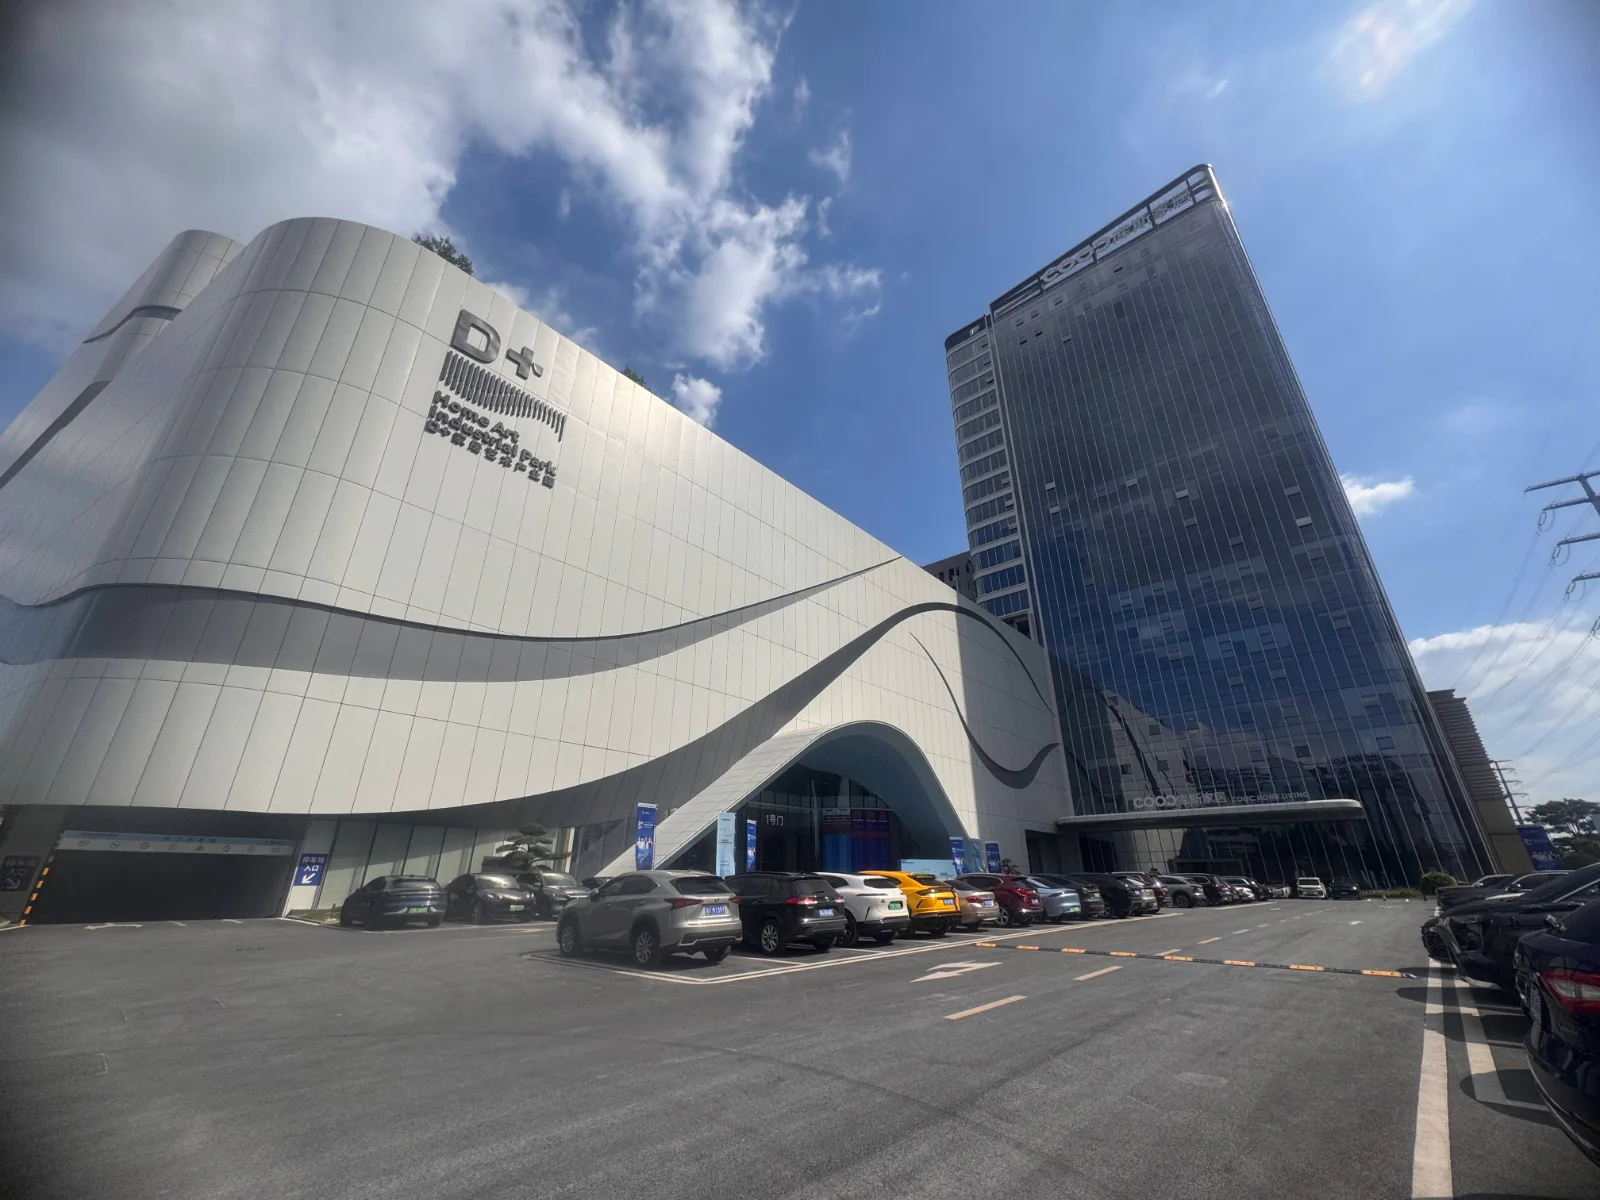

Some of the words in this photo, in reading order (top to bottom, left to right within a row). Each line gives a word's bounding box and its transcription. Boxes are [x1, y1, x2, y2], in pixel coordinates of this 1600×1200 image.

[432, 390, 490, 429] Home
[490, 421, 520, 444] Art
[428, 403, 519, 459] Industrial
[519, 448, 557, 477] Park
[765, 814, 784, 826] 1号门
[302, 856, 325, 864] 停车场
